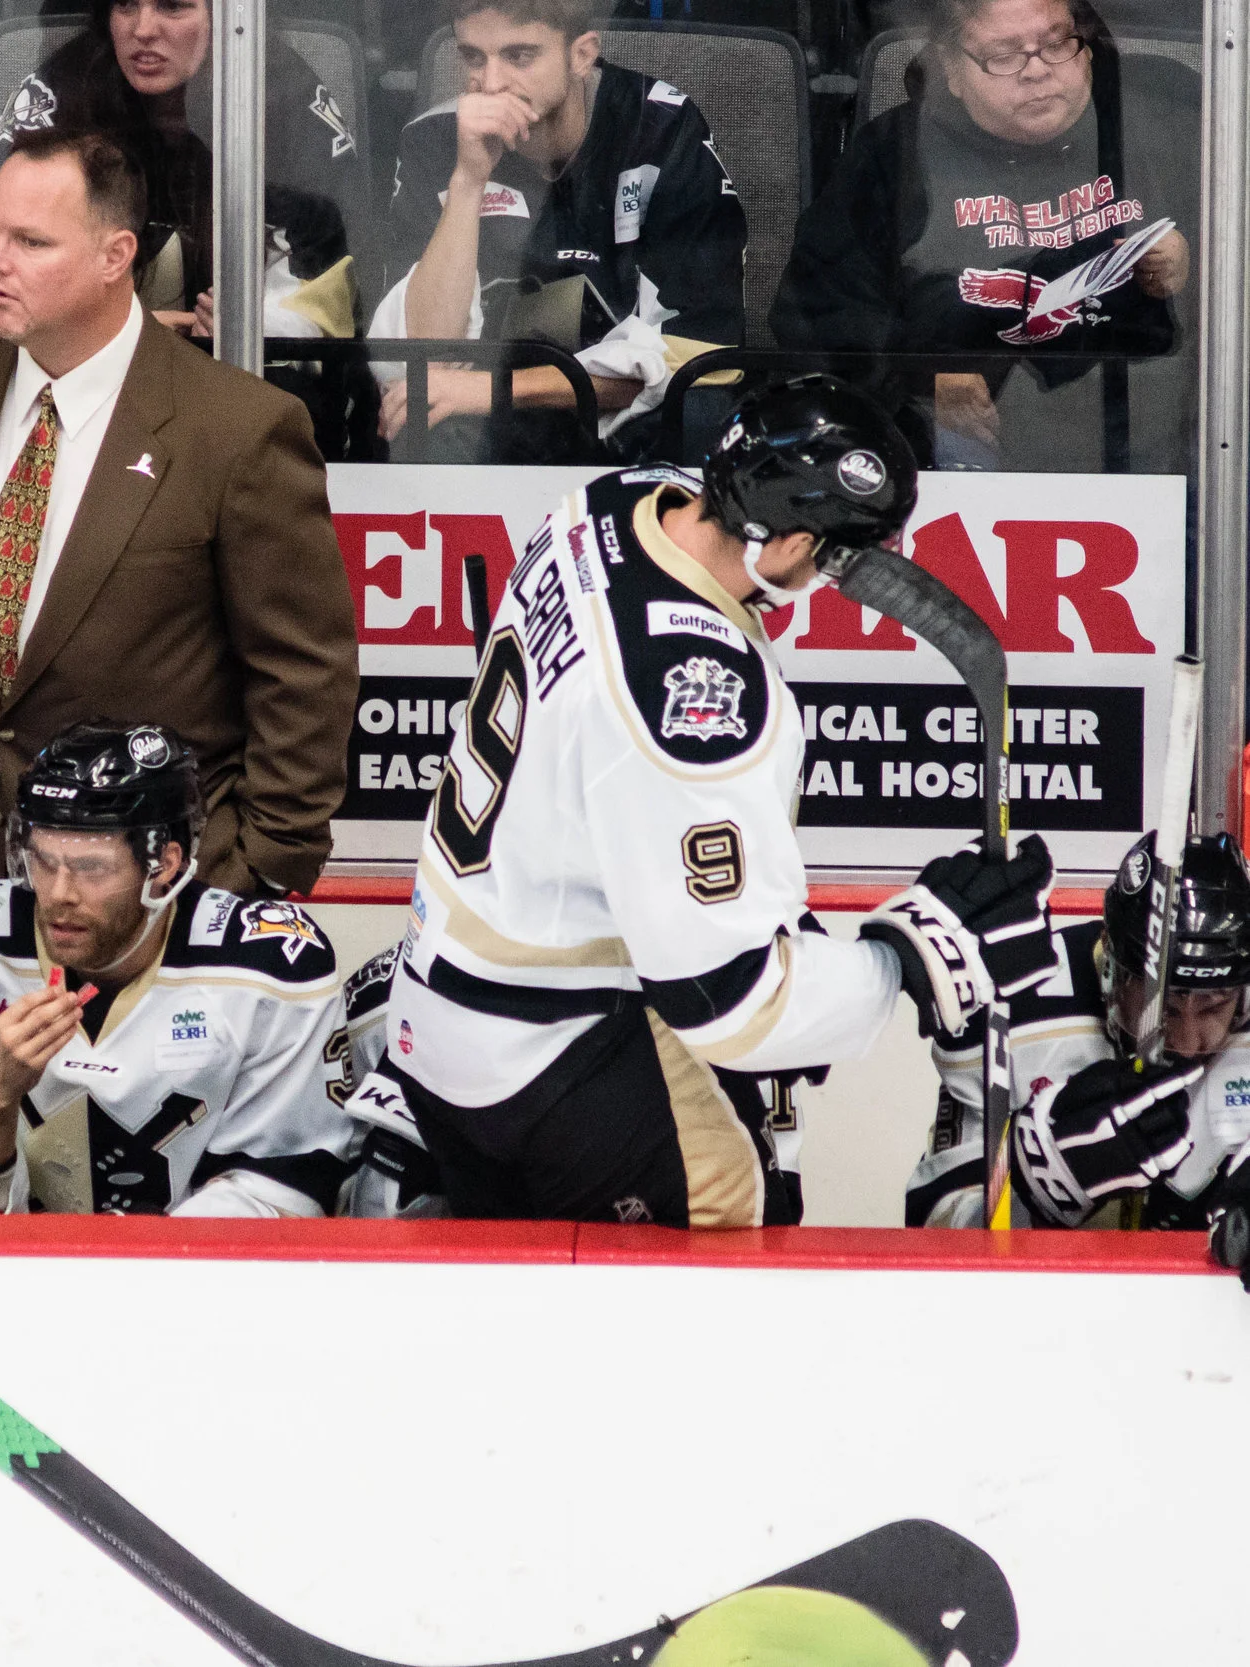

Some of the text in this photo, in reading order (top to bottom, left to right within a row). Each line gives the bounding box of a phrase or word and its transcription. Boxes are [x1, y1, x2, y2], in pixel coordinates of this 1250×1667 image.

[954, 175, 1114, 227] WHEELING
[985, 199, 1143, 249] THUNDERBIRDS
[722, 423, 745, 450] 9
[601, 514, 624, 564] CCM
[669, 613, 730, 639] Gulfport
[803, 705, 907, 742] ICAL
[430, 624, 527, 878] 9
[359, 755, 449, 790] EAS
[881, 762, 1102, 800] HOSITAL
[31, 784, 78, 799] CCM
[681, 820, 746, 905] 9
[1143, 878, 1167, 981] CCM
[1176, 965, 1233, 980] CCM
[64, 1060, 119, 1073] CCM
